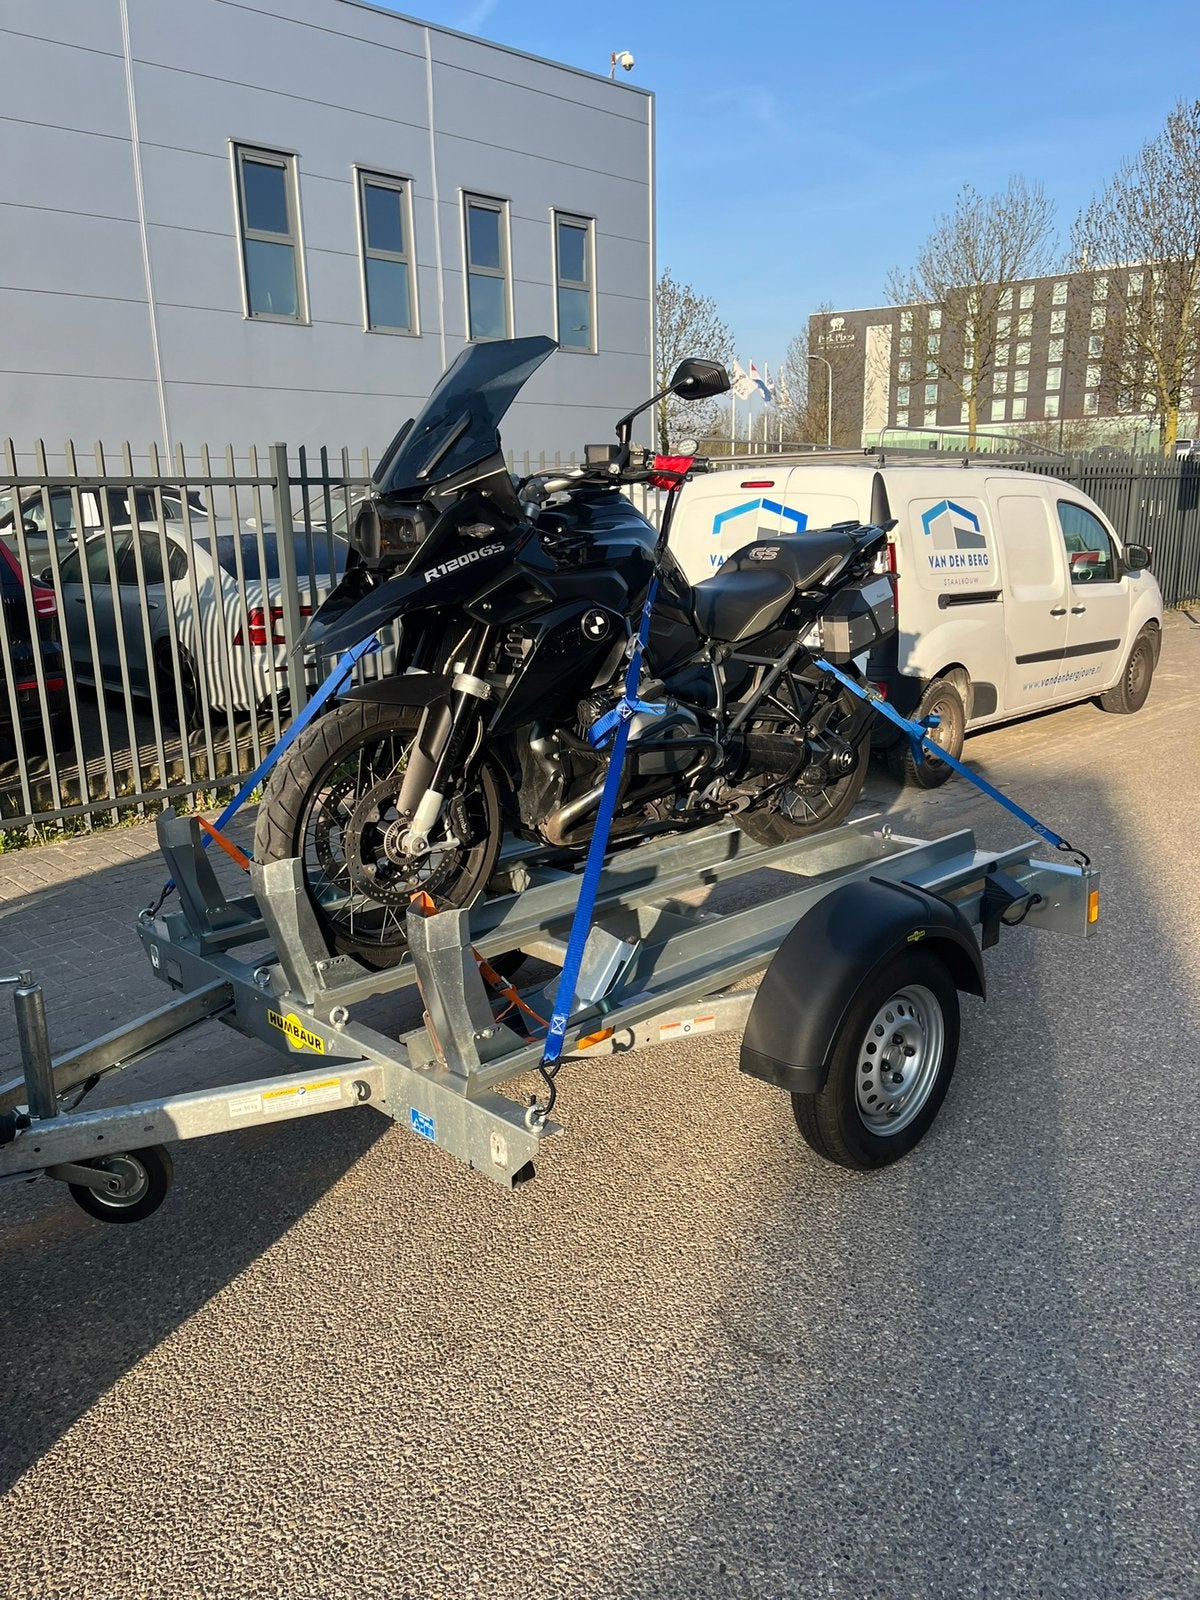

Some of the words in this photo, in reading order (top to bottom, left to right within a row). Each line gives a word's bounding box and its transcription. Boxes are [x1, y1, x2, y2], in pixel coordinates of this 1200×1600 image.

[710, 554, 730, 567] VA
[749, 546, 780, 561] GS
[928, 555, 947, 568] VAN
[949, 554, 966, 568] DEN
[967, 553, 989, 567] BERG
[943, 577, 979, 586] STAALBOUW
[269, 1011, 322, 1051] HUMBAUR
